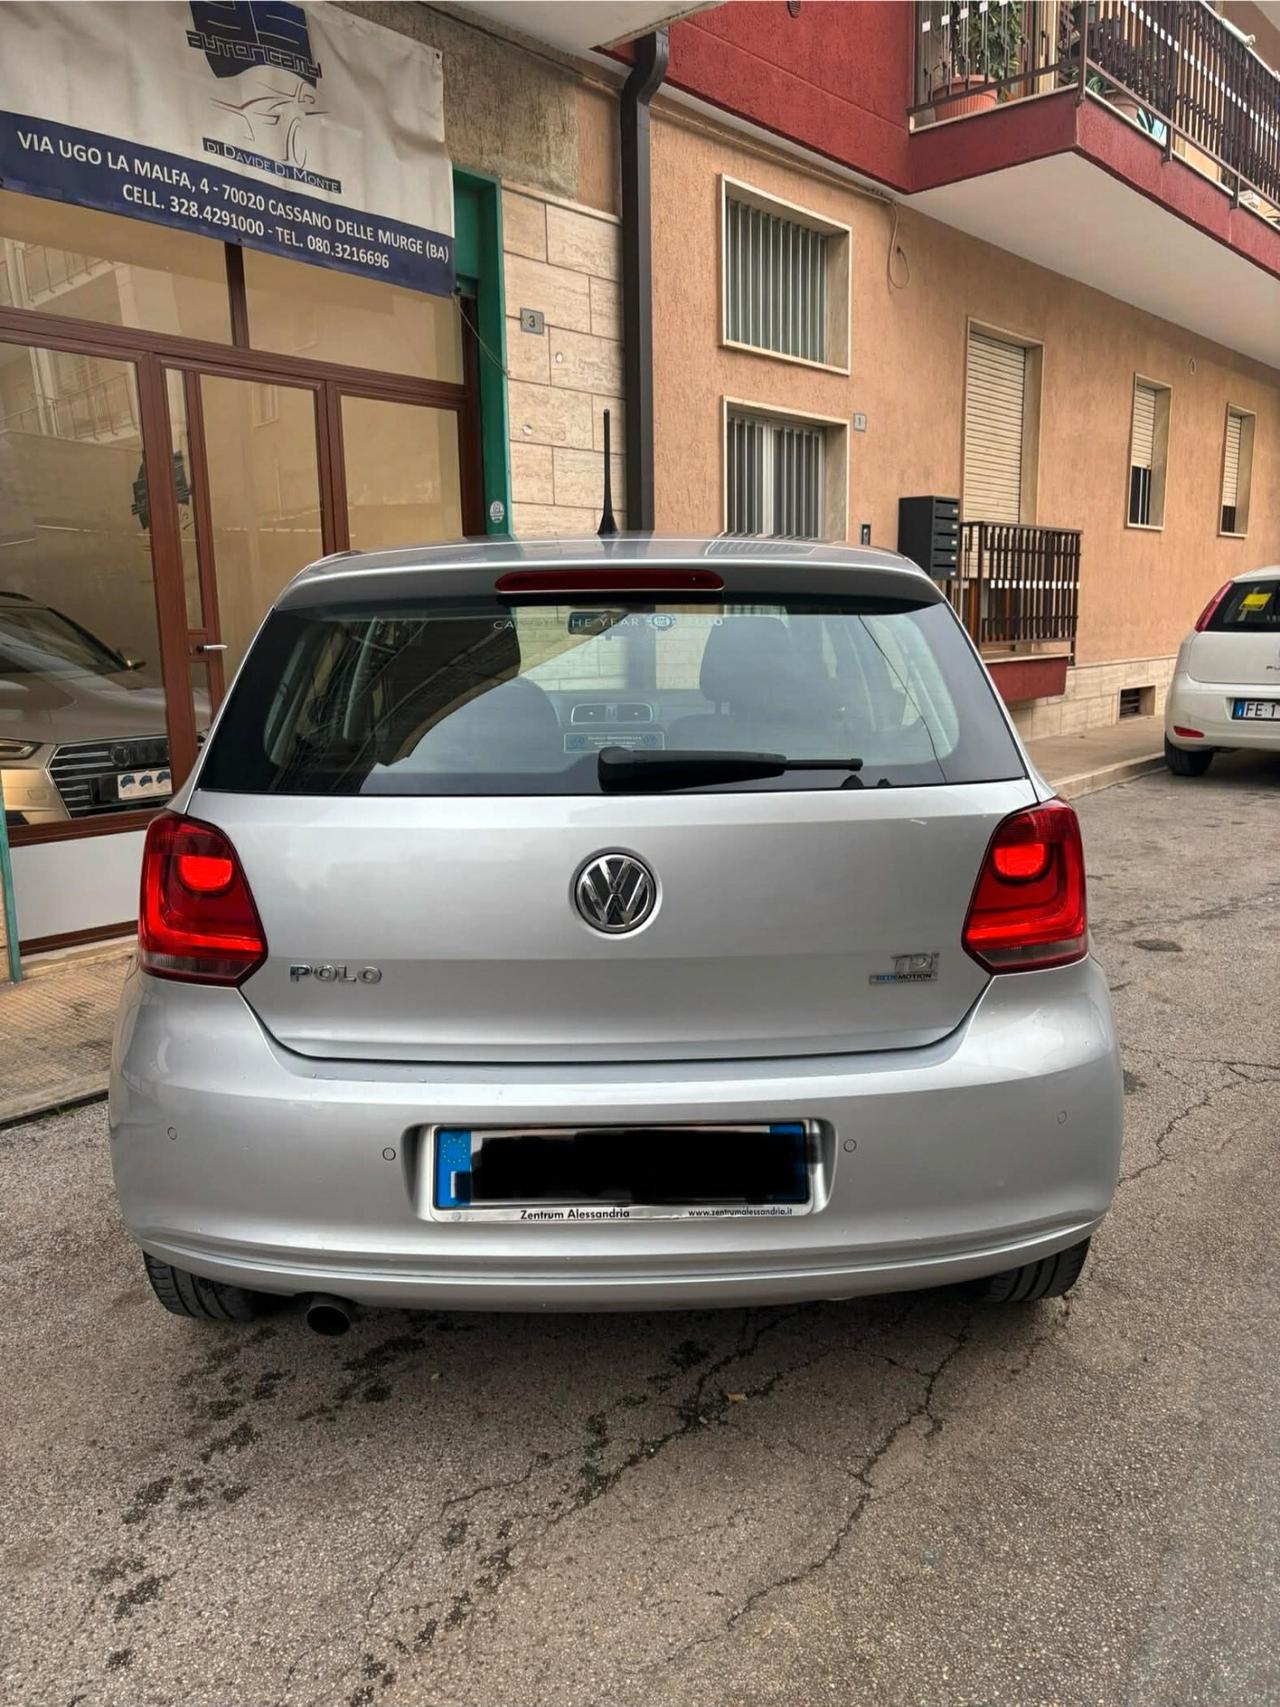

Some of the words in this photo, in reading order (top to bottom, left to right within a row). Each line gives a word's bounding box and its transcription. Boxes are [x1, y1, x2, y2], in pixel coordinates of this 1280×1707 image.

[17, 131, 54, 154] VIA
[59, 140, 102, 165] UGO
[107, 152, 129, 172] LA
[134, 160, 195, 193] MALFA,
[200, 178, 210, 194] 4
[222, 184, 265, 211] 70020
[268, 200, 332, 231] CASSANO
[336, 219, 374, 241] DELLE
[378, 229, 423, 254] MURGE
[425, 241, 449, 264] (BA)
[123, 184, 165, 209] CELL.
[170, 196, 264, 237] 328.4291000
[276, 226, 303, 248] TEL.
[307, 235, 390, 269] 080.3216696
[529, 315, 536, 328] 3
[599, 616, 640, 628] YEAR
[289, 964, 383, 985] POLO
[520, 1209, 564, 1220] Zentrum
[567, 1208, 630, 1220] Alessandria
